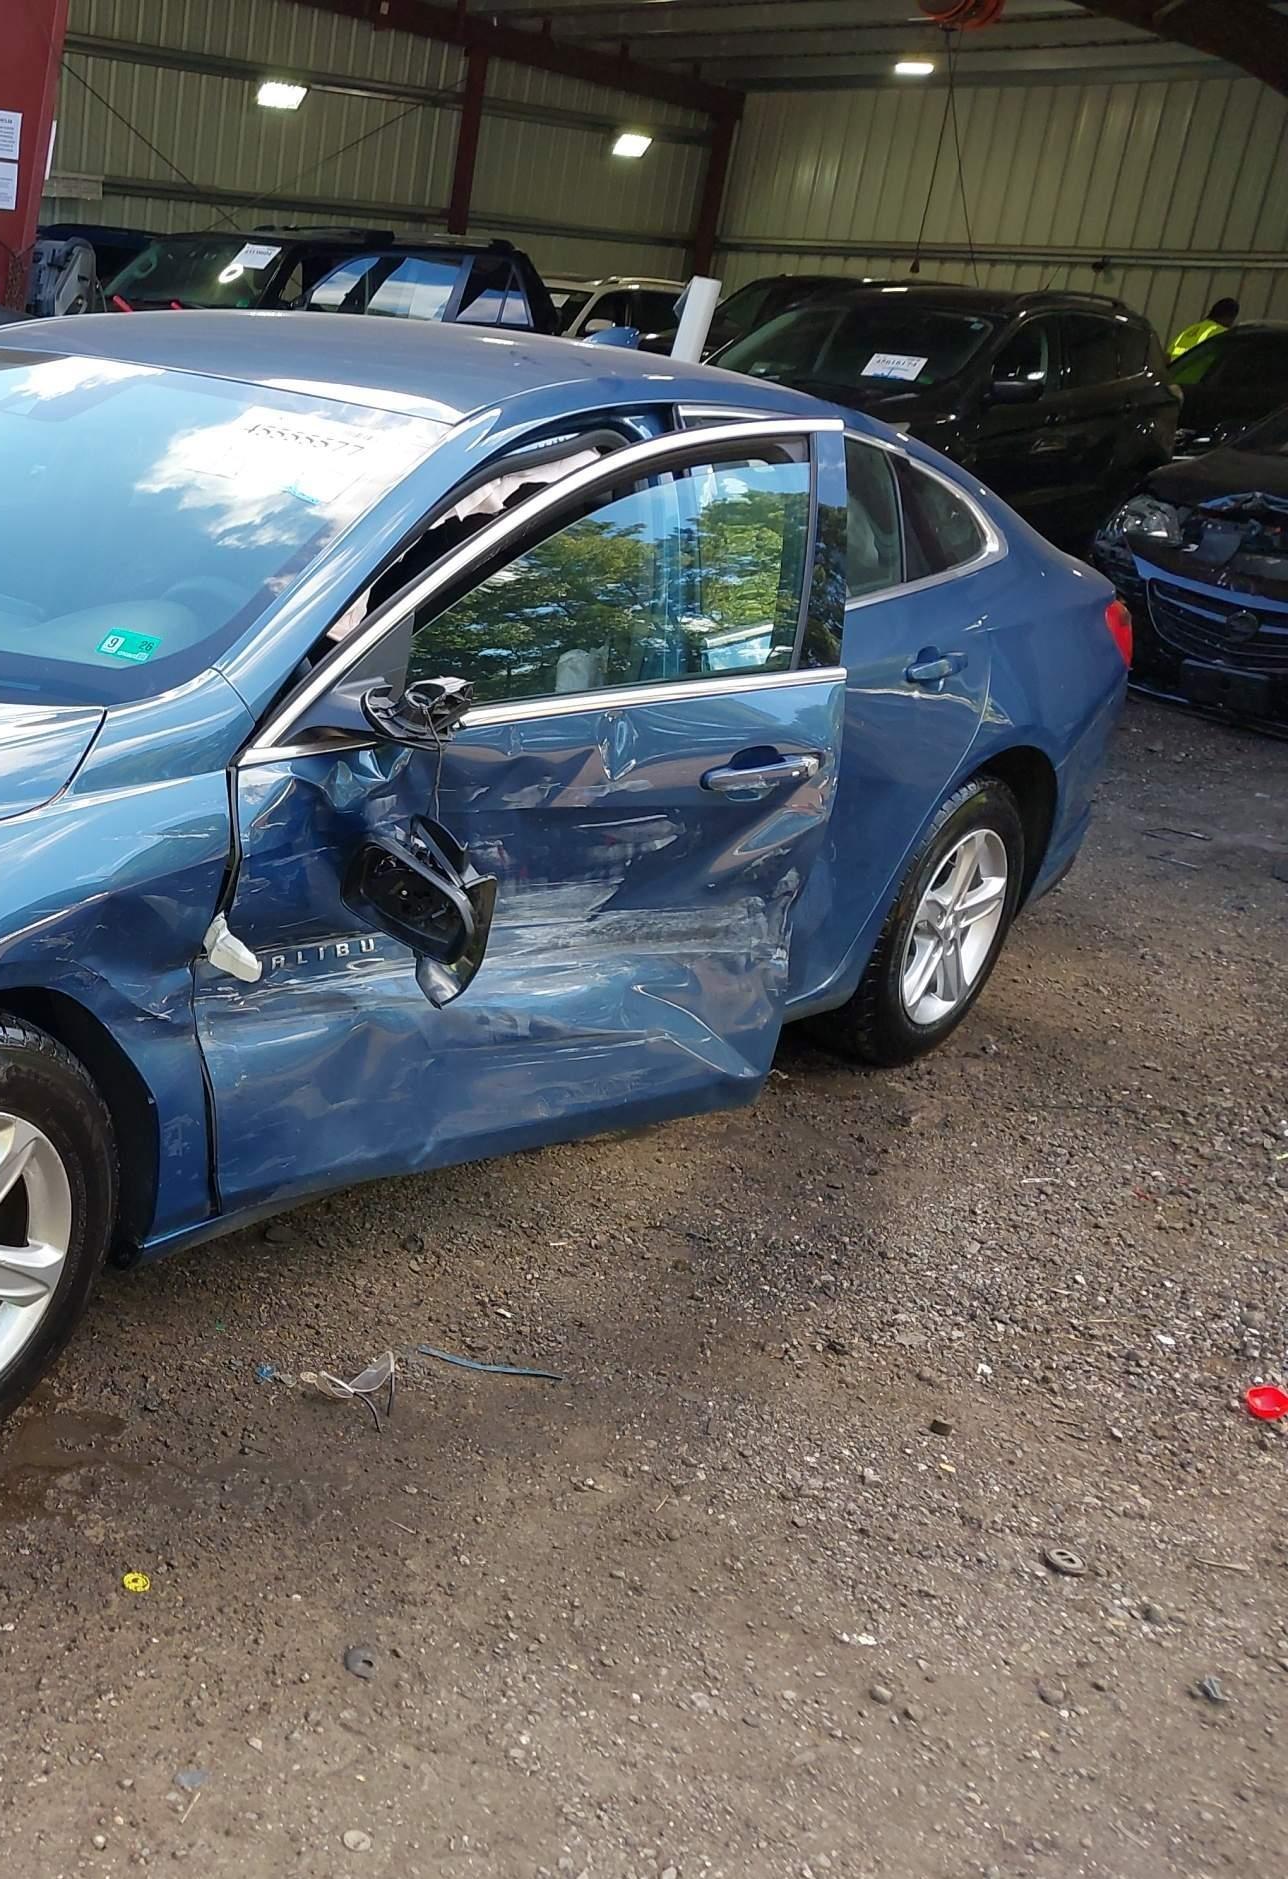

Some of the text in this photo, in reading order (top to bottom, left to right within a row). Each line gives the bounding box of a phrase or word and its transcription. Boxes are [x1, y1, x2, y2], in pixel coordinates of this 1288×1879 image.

[107, 637, 155, 652] 9 26
[271, 938, 376, 971] ALIBU
